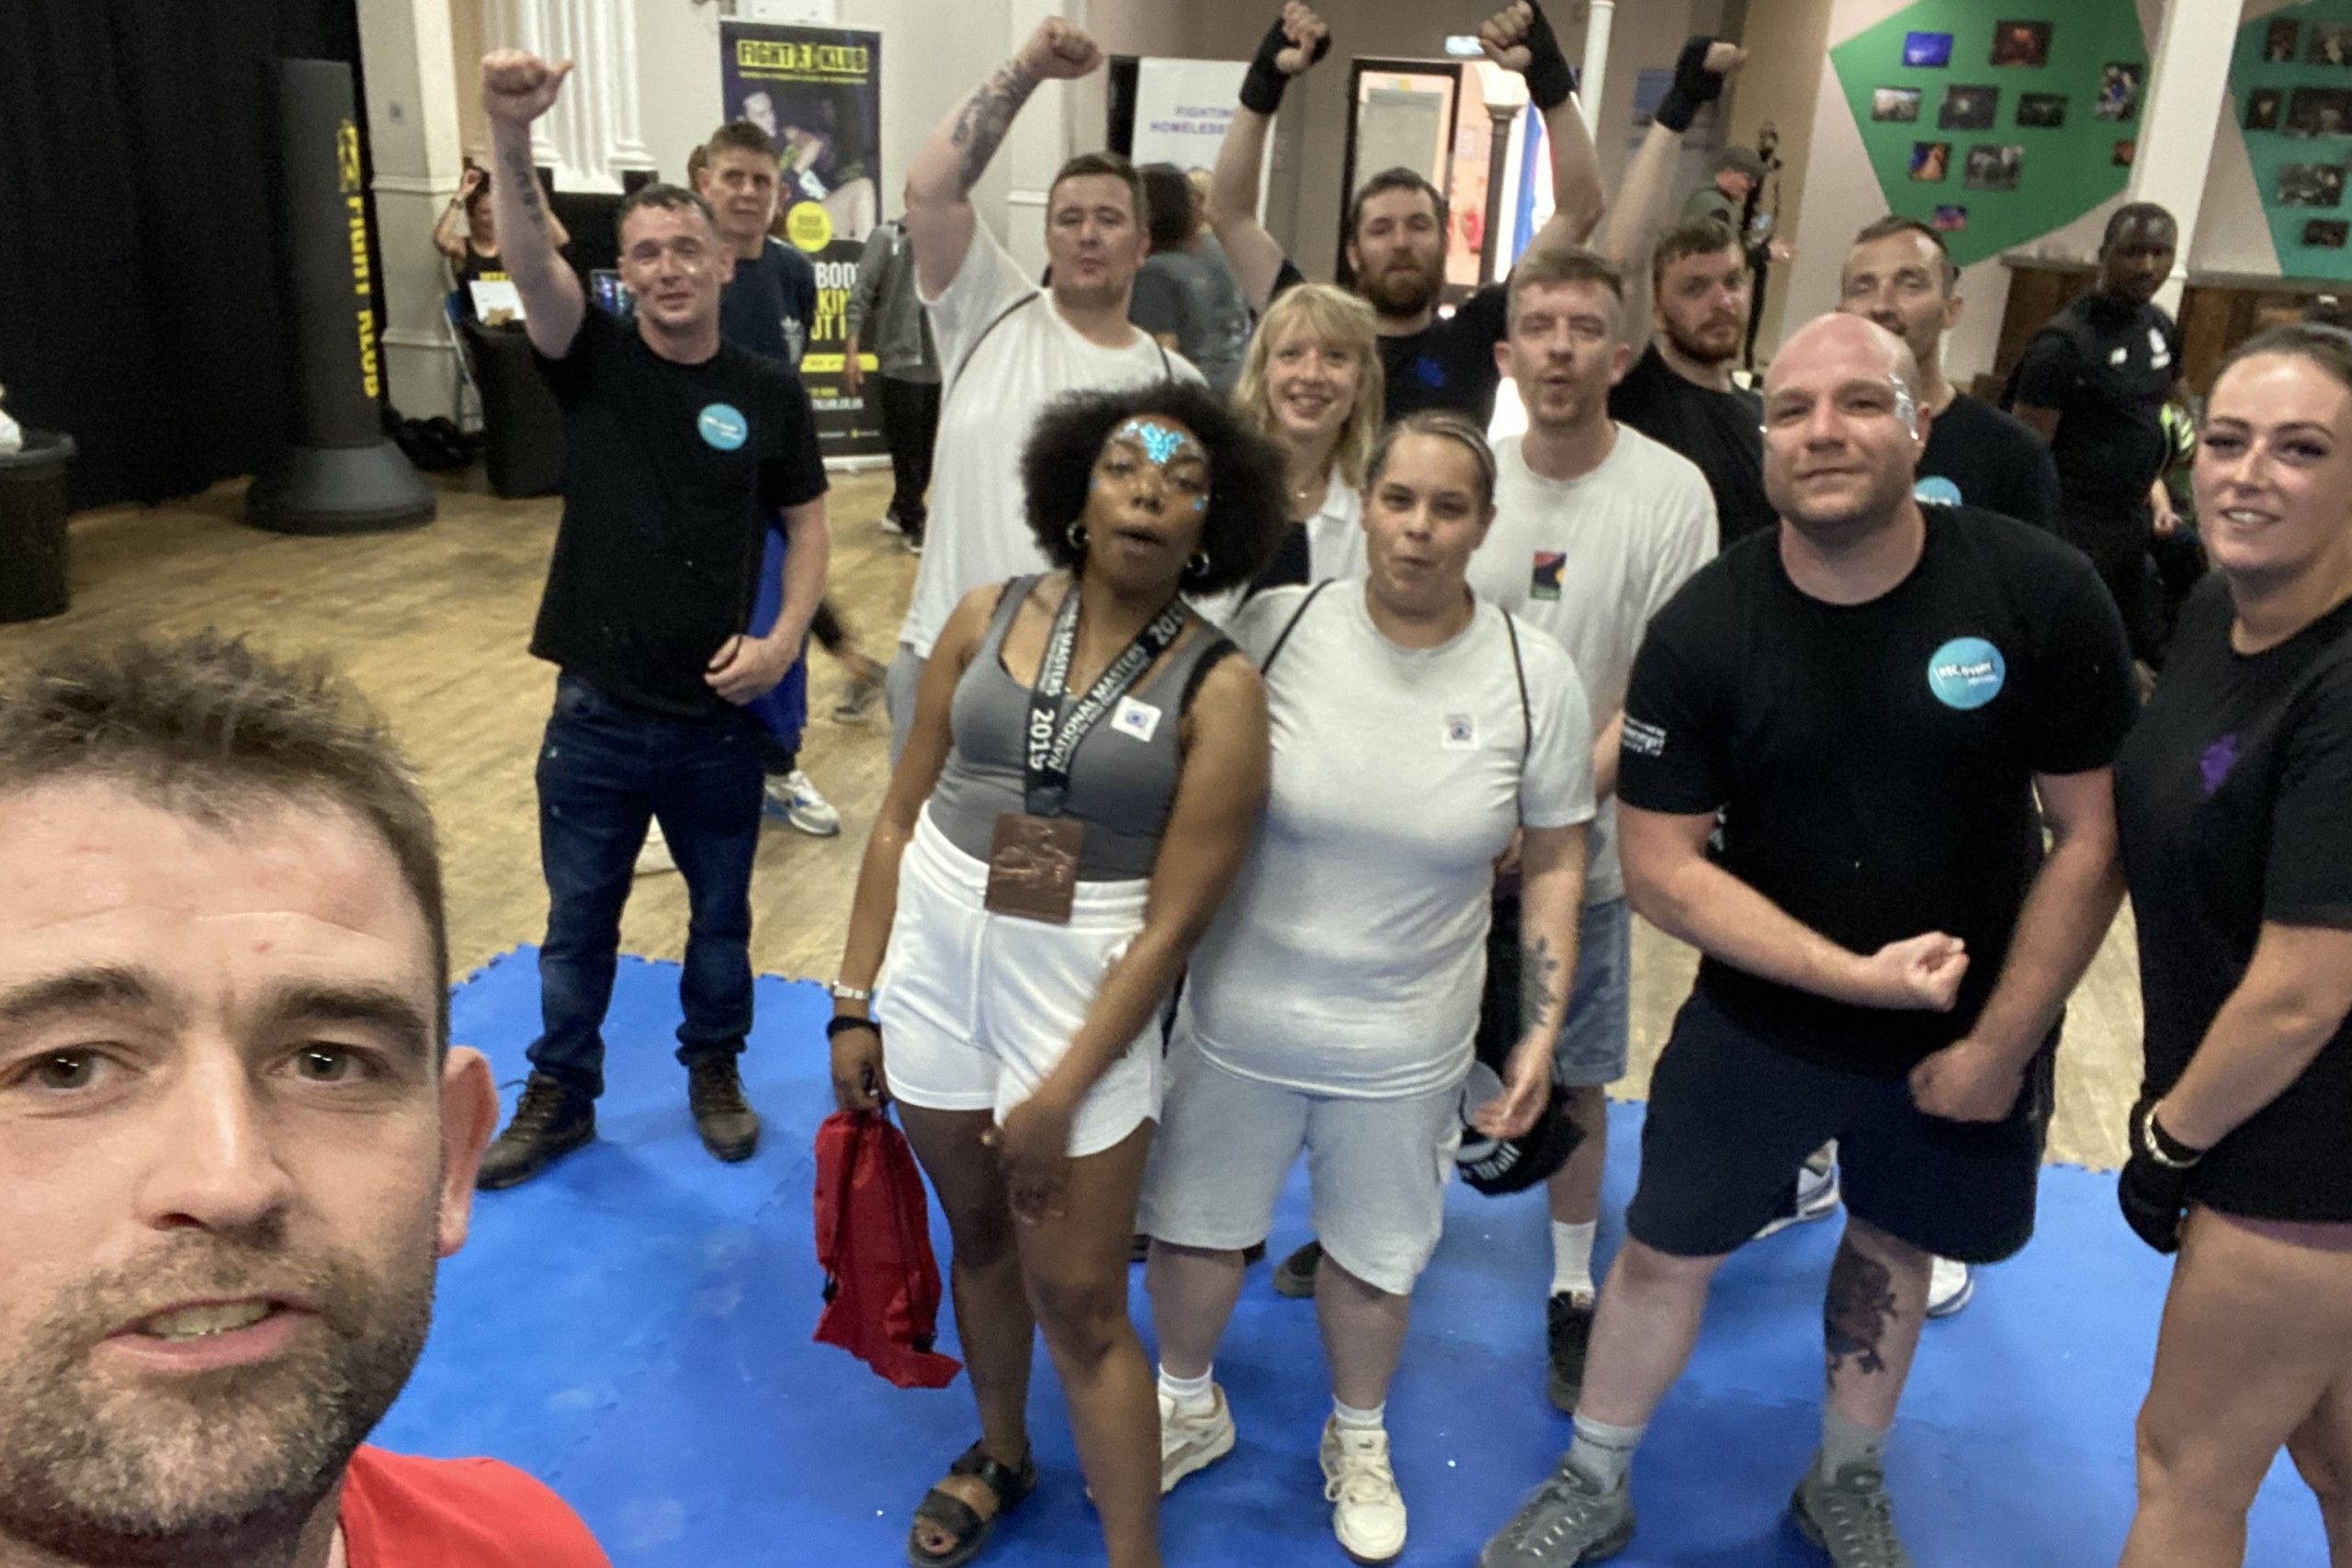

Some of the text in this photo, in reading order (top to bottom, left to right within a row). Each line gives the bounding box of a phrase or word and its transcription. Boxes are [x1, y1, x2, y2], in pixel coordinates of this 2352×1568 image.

[739, 41, 795, 69] FIGHT
[814, 262, 860, 289] BOD
[1046, 697, 1097, 770] NATIONAL
[1091, 644, 1148, 698] MASTERS
